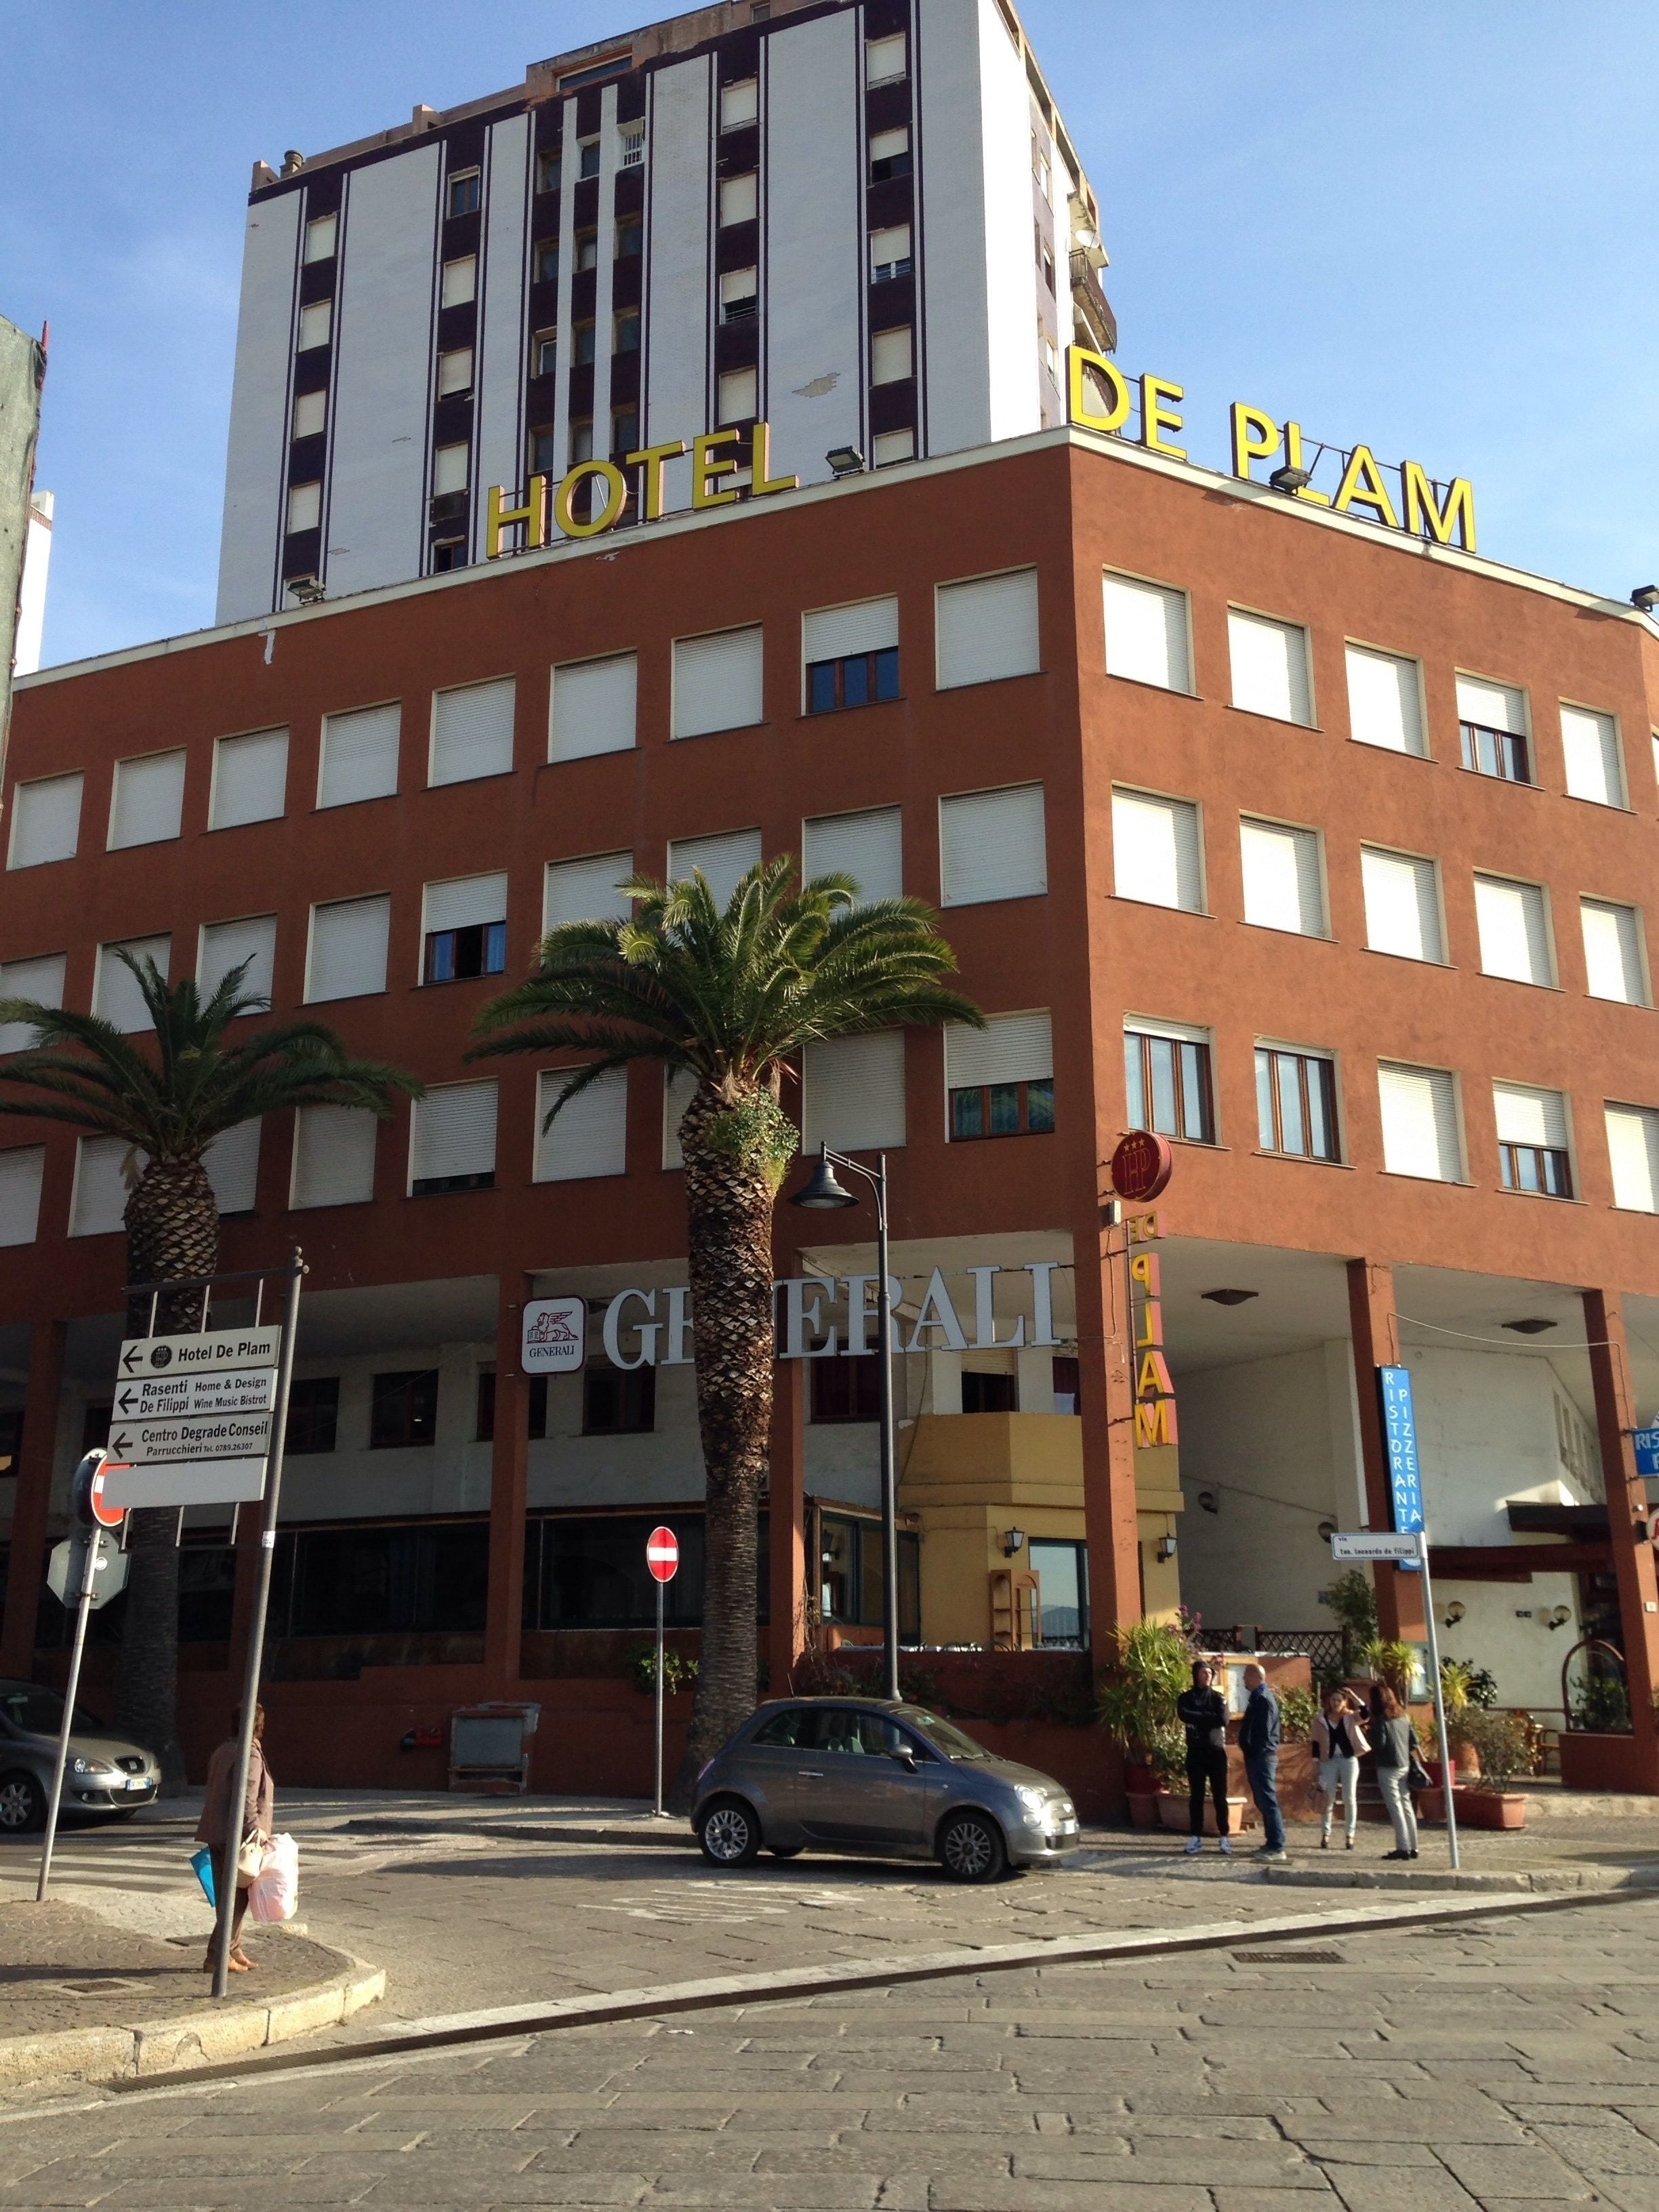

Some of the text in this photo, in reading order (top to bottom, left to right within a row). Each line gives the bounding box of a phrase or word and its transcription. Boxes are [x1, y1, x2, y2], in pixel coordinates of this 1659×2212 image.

[1065, 344, 1477, 554] DE PLAM
[486, 422, 800, 560] HOTEL
[603, 1261, 1062, 1370] GEERALI
[178, 1341, 270, 1362] Hotel De Plam
[529, 1345, 575, 1358] GENERALI
[142, 1377, 266, 1396] Rasenti Home & Design
[140, 1394, 267, 1414] De Filippi Wine Music Bistrot
[142, 1421, 268, 1442] Centro Degrade Conseil
[146, 1443, 202, 1456] Parrucchieri
[216, 1442, 253, 1452] 0789.26307
[1399, 1389, 1422, 1523] PIZZERIA
